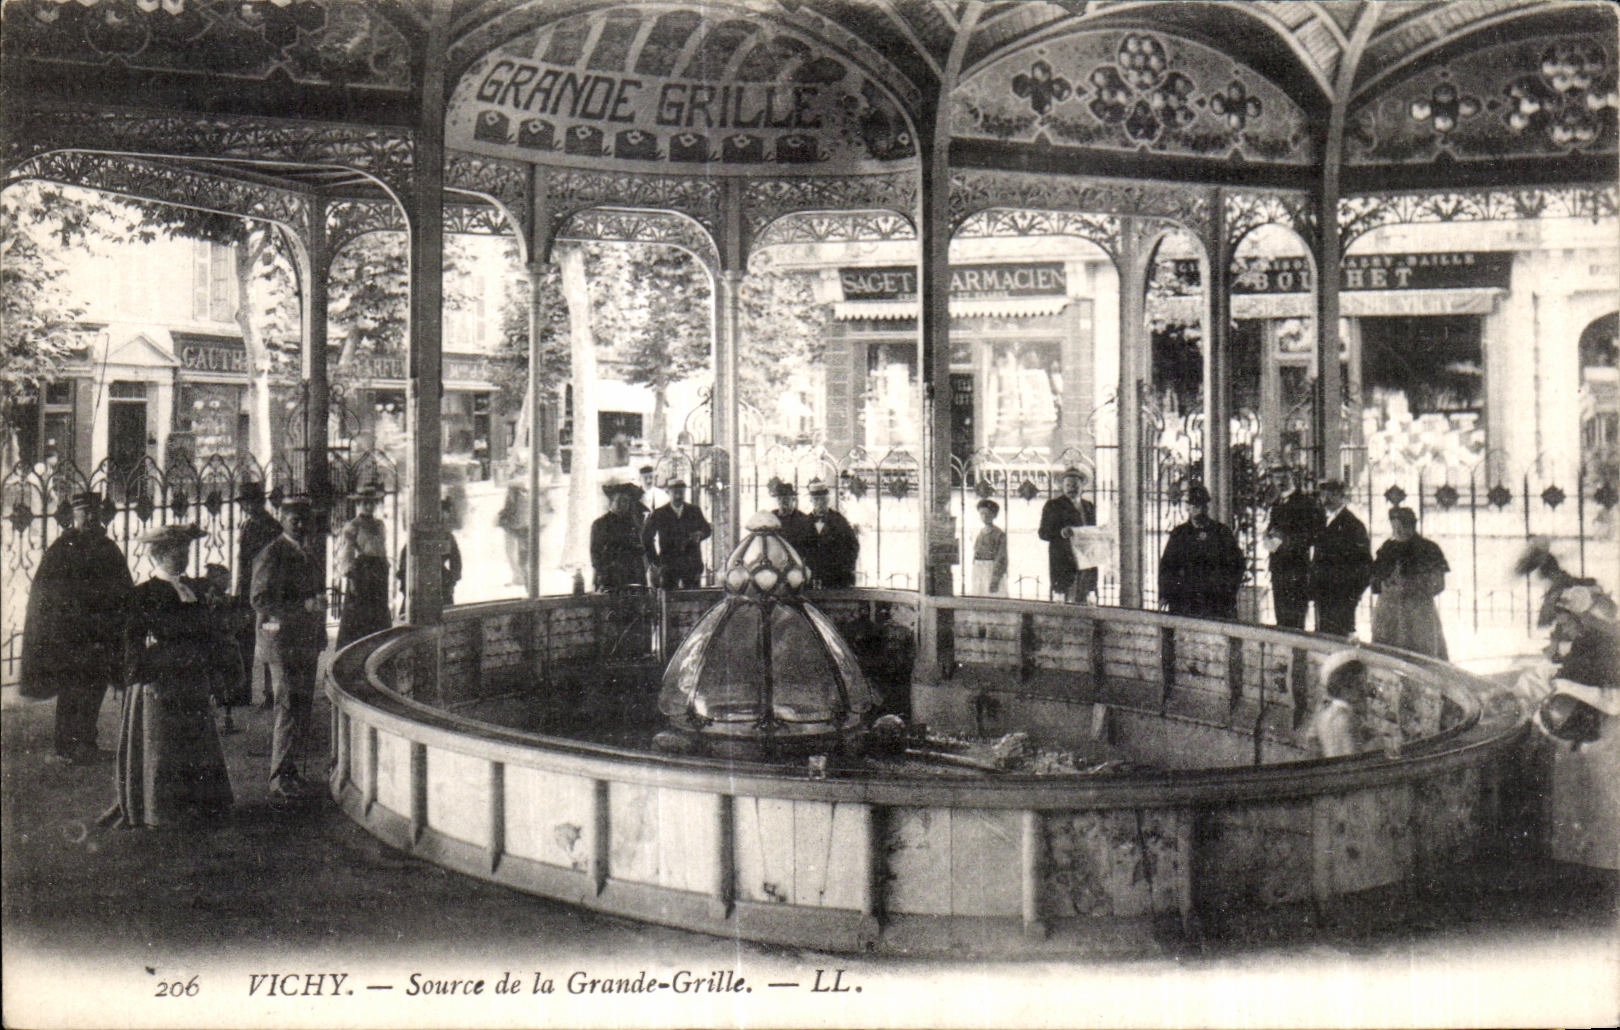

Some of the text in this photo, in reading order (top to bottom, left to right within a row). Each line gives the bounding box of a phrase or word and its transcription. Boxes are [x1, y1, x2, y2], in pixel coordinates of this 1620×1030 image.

[475, 59, 823, 129] GRANDE GRILLE
[841, 268, 1066, 294] SAGET ARMACIEN
[1253, 267, 1413, 291] BOUHET
